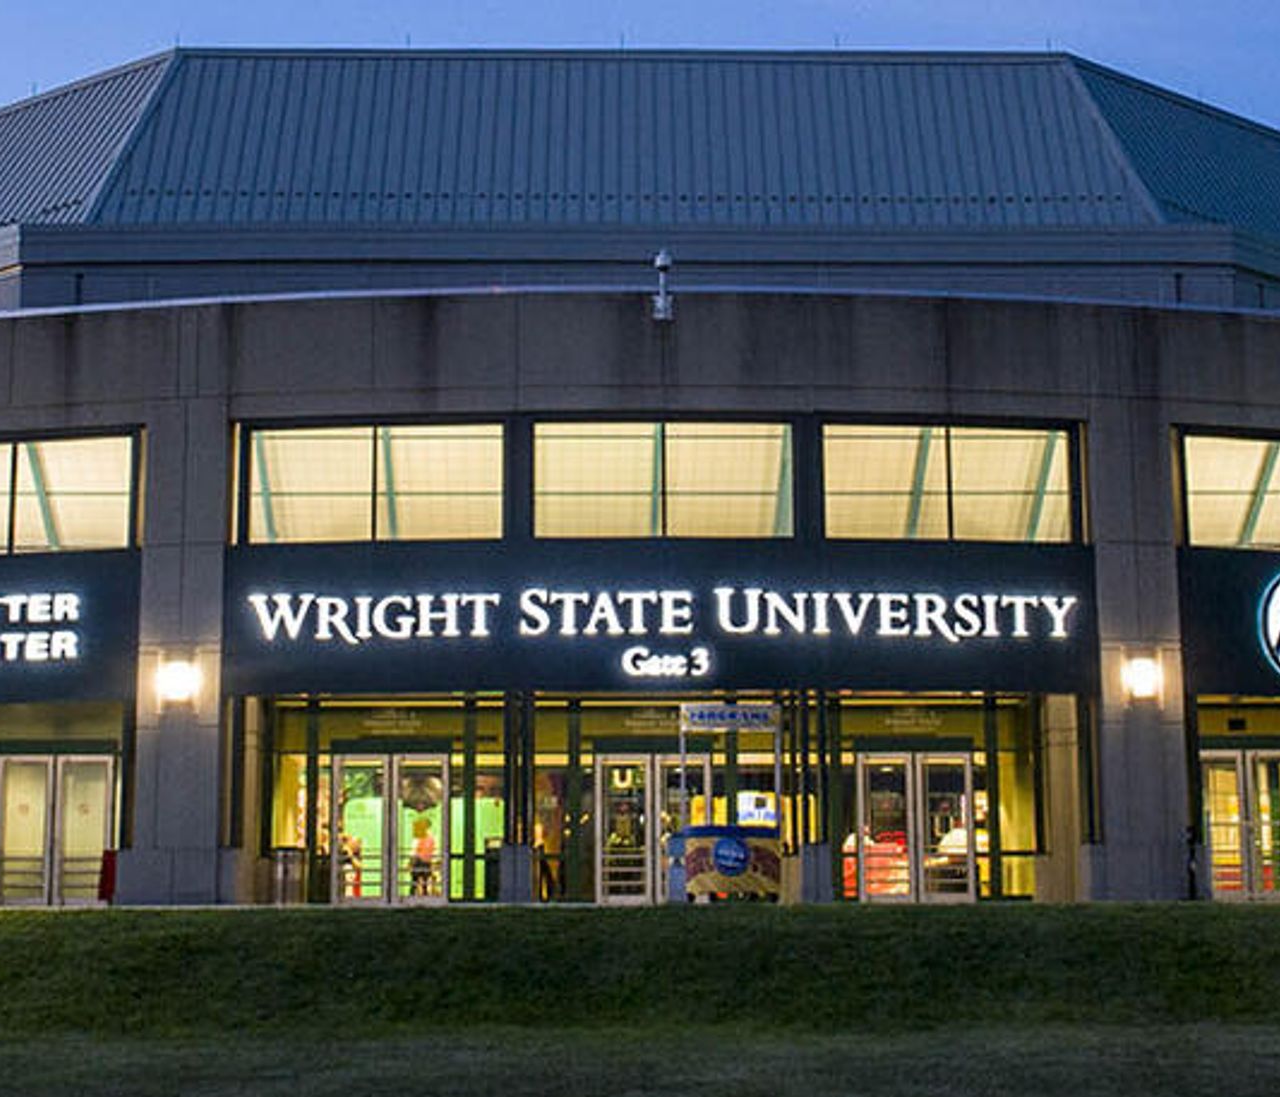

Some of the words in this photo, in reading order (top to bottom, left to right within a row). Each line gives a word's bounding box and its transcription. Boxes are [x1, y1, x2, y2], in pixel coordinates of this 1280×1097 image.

[247, 592, 501, 645] WRIGHT
[519, 587, 694, 636] STATE
[713, 586, 1078, 643] UNIVERSITY
[690, 647, 710, 677] 3
